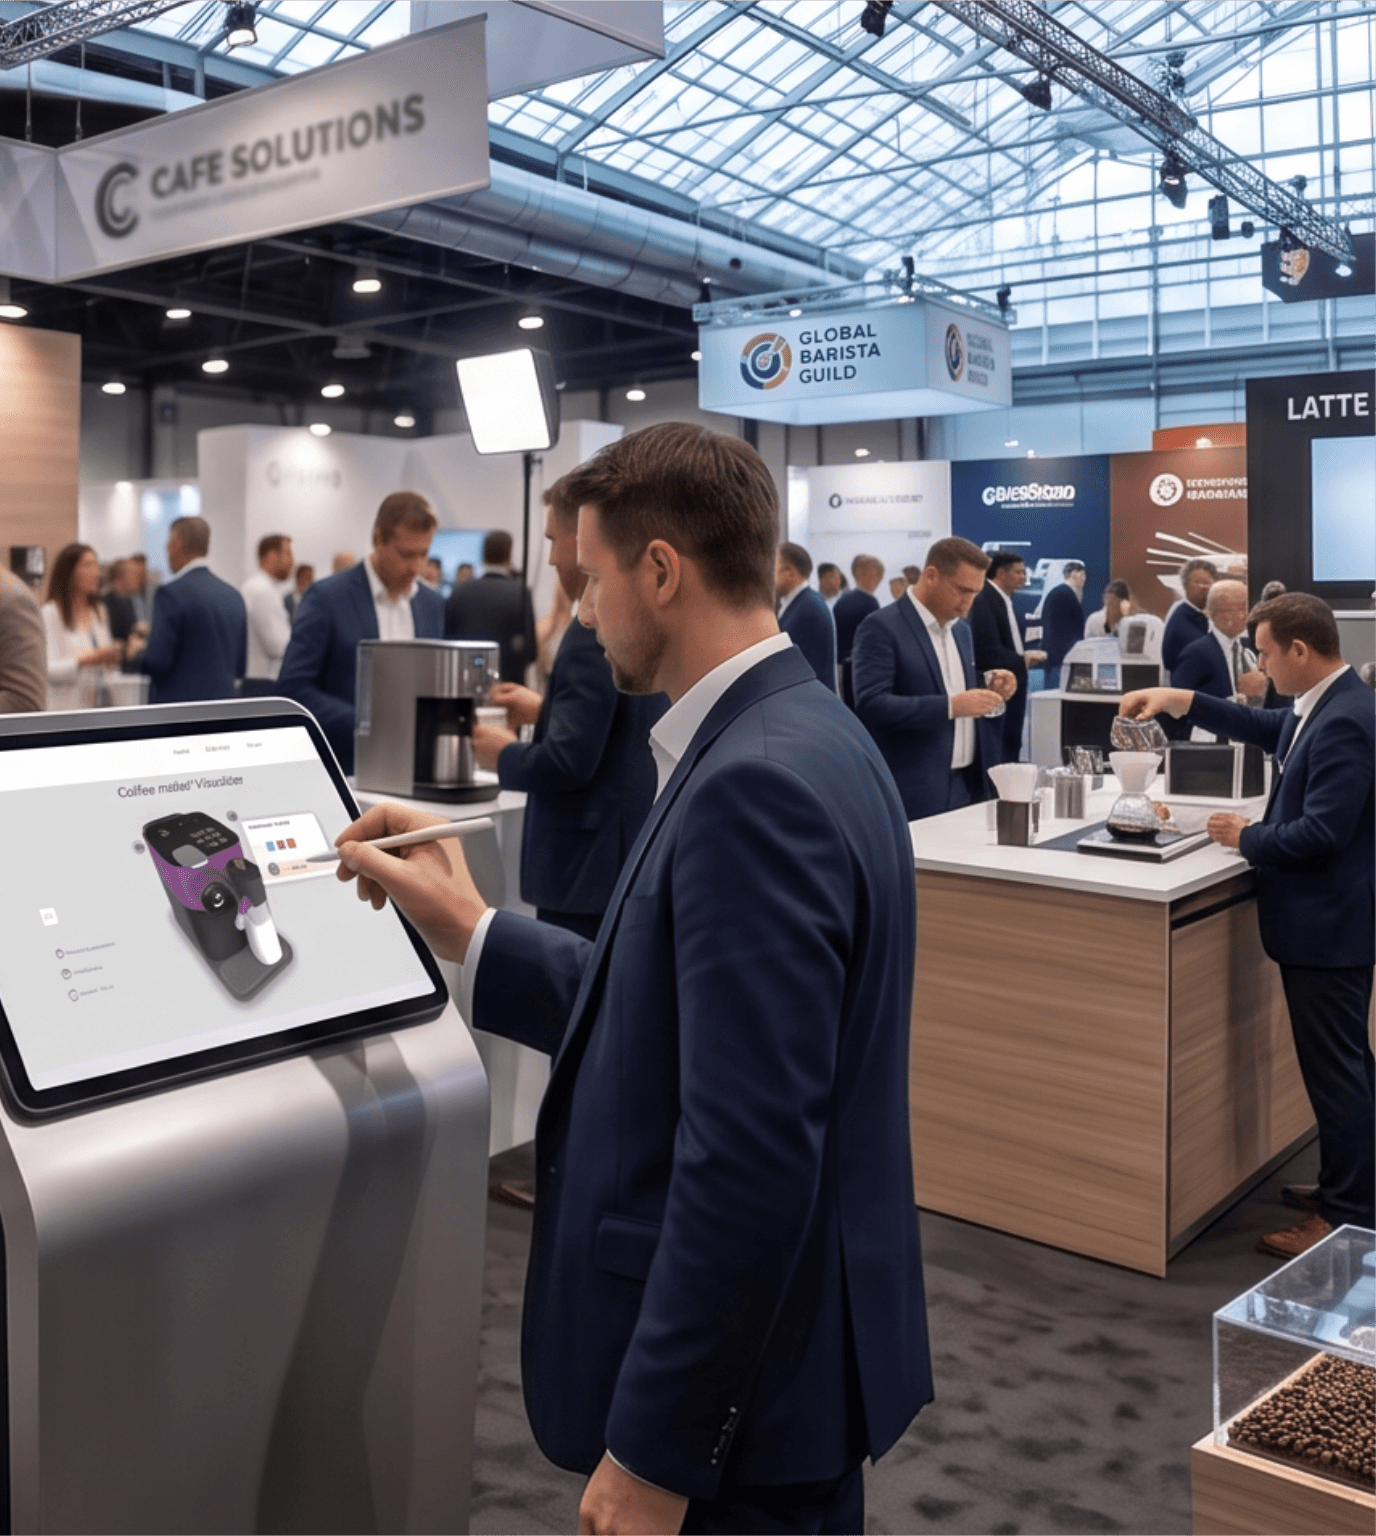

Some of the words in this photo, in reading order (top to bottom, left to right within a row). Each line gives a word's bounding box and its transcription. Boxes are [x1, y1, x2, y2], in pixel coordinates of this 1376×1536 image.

[150, 149, 224, 199] CAFE
[230, 93, 427, 179] SOLUTIONS
[798, 323, 878, 346] GLOBAL
[799, 342, 881, 365] BARISTA
[798, 365, 857, 384] GUILD
[1287, 391, 1370, 421] LATTE
